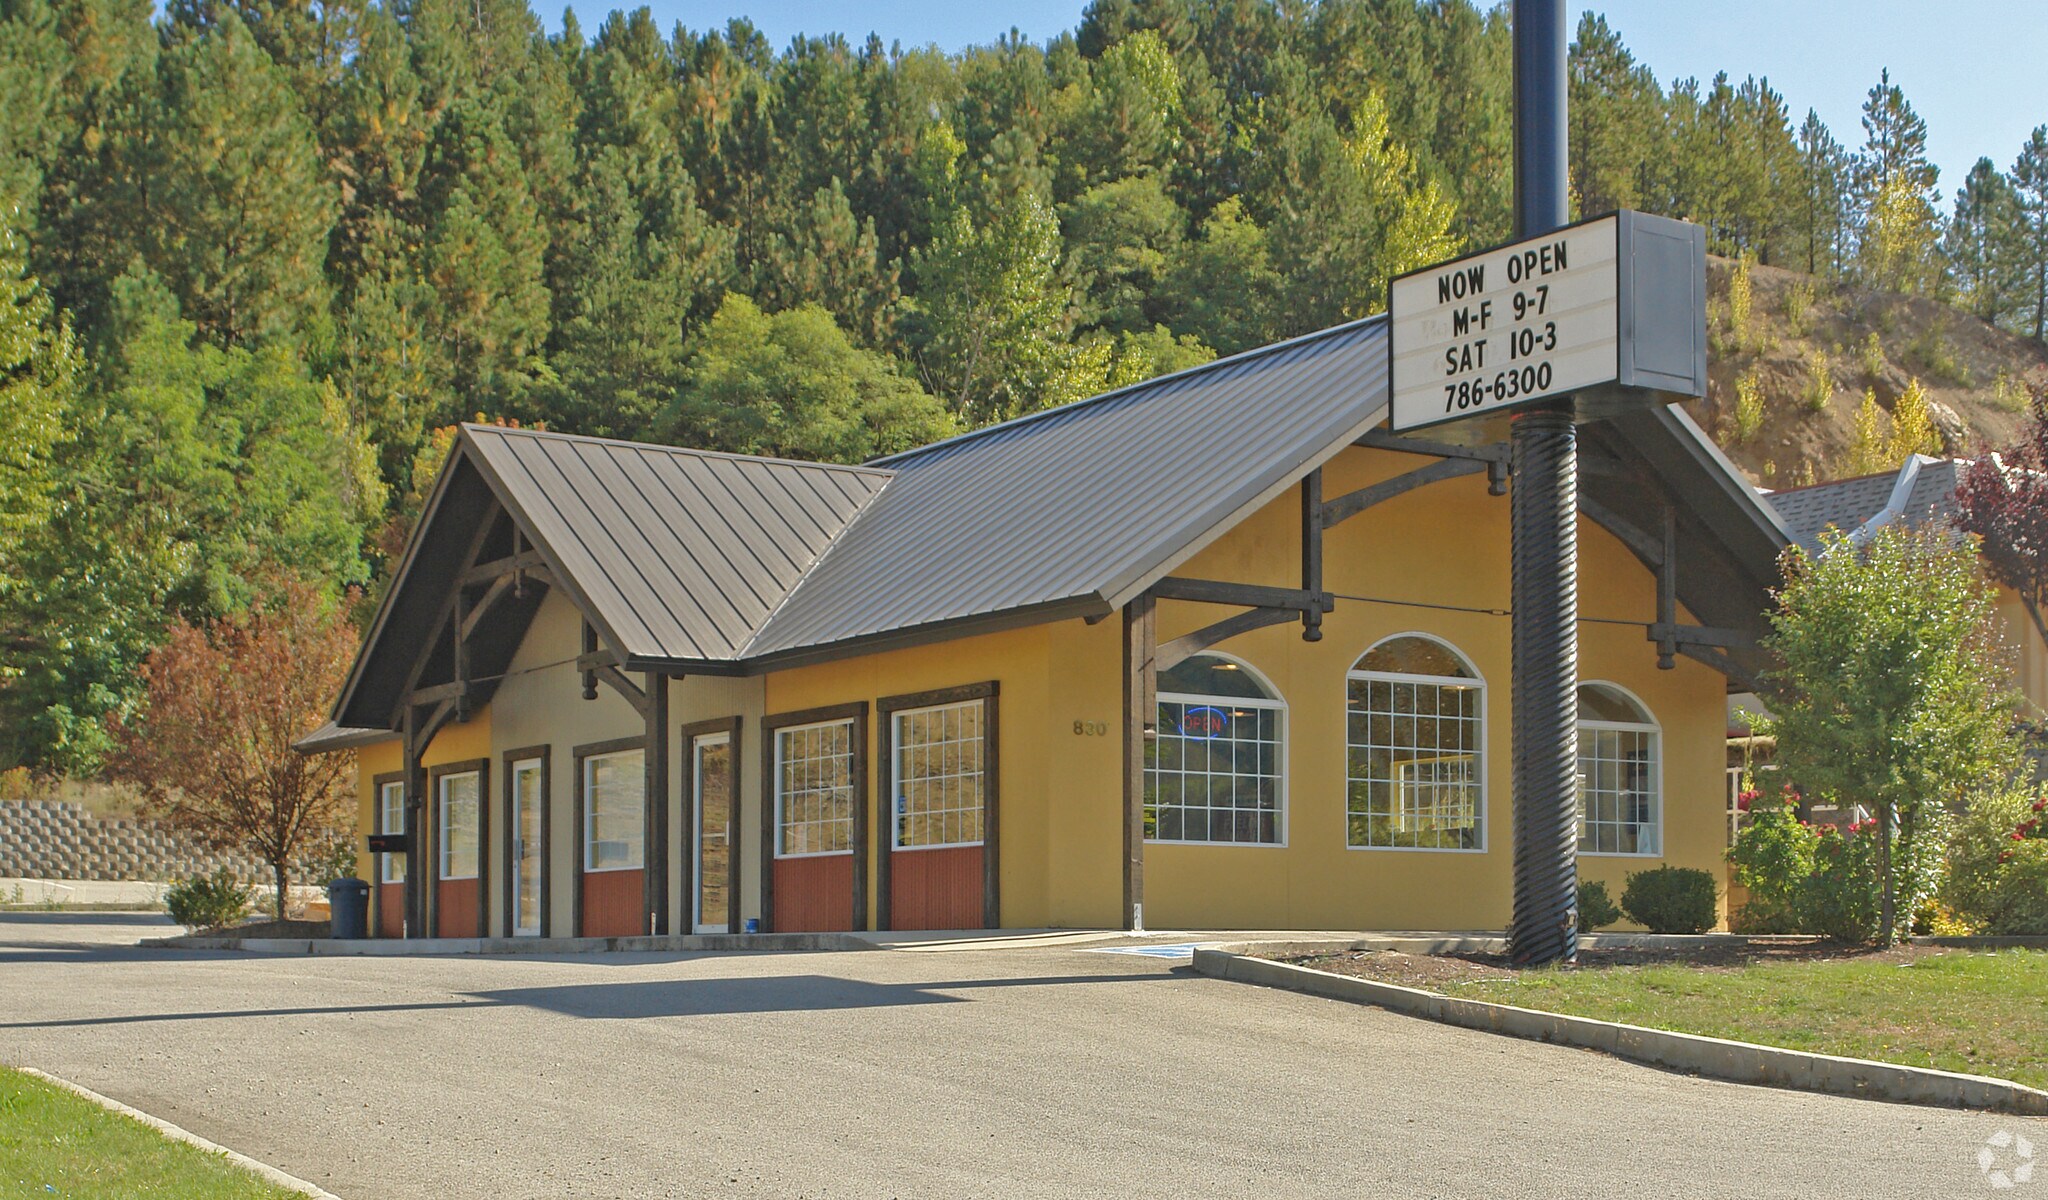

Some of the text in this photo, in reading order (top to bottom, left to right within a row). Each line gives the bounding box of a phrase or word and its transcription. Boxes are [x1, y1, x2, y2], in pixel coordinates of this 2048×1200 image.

[1438, 240, 1568, 304] NOW OPEN
[1453, 285, 1549, 337] M-F 9-7
[1445, 321, 1557, 375] SAT 10-3
[1444, 361, 1552, 412] 786-6300
[1073, 719, 1107, 737] 830
[1184, 715, 1221, 732] OPEN
